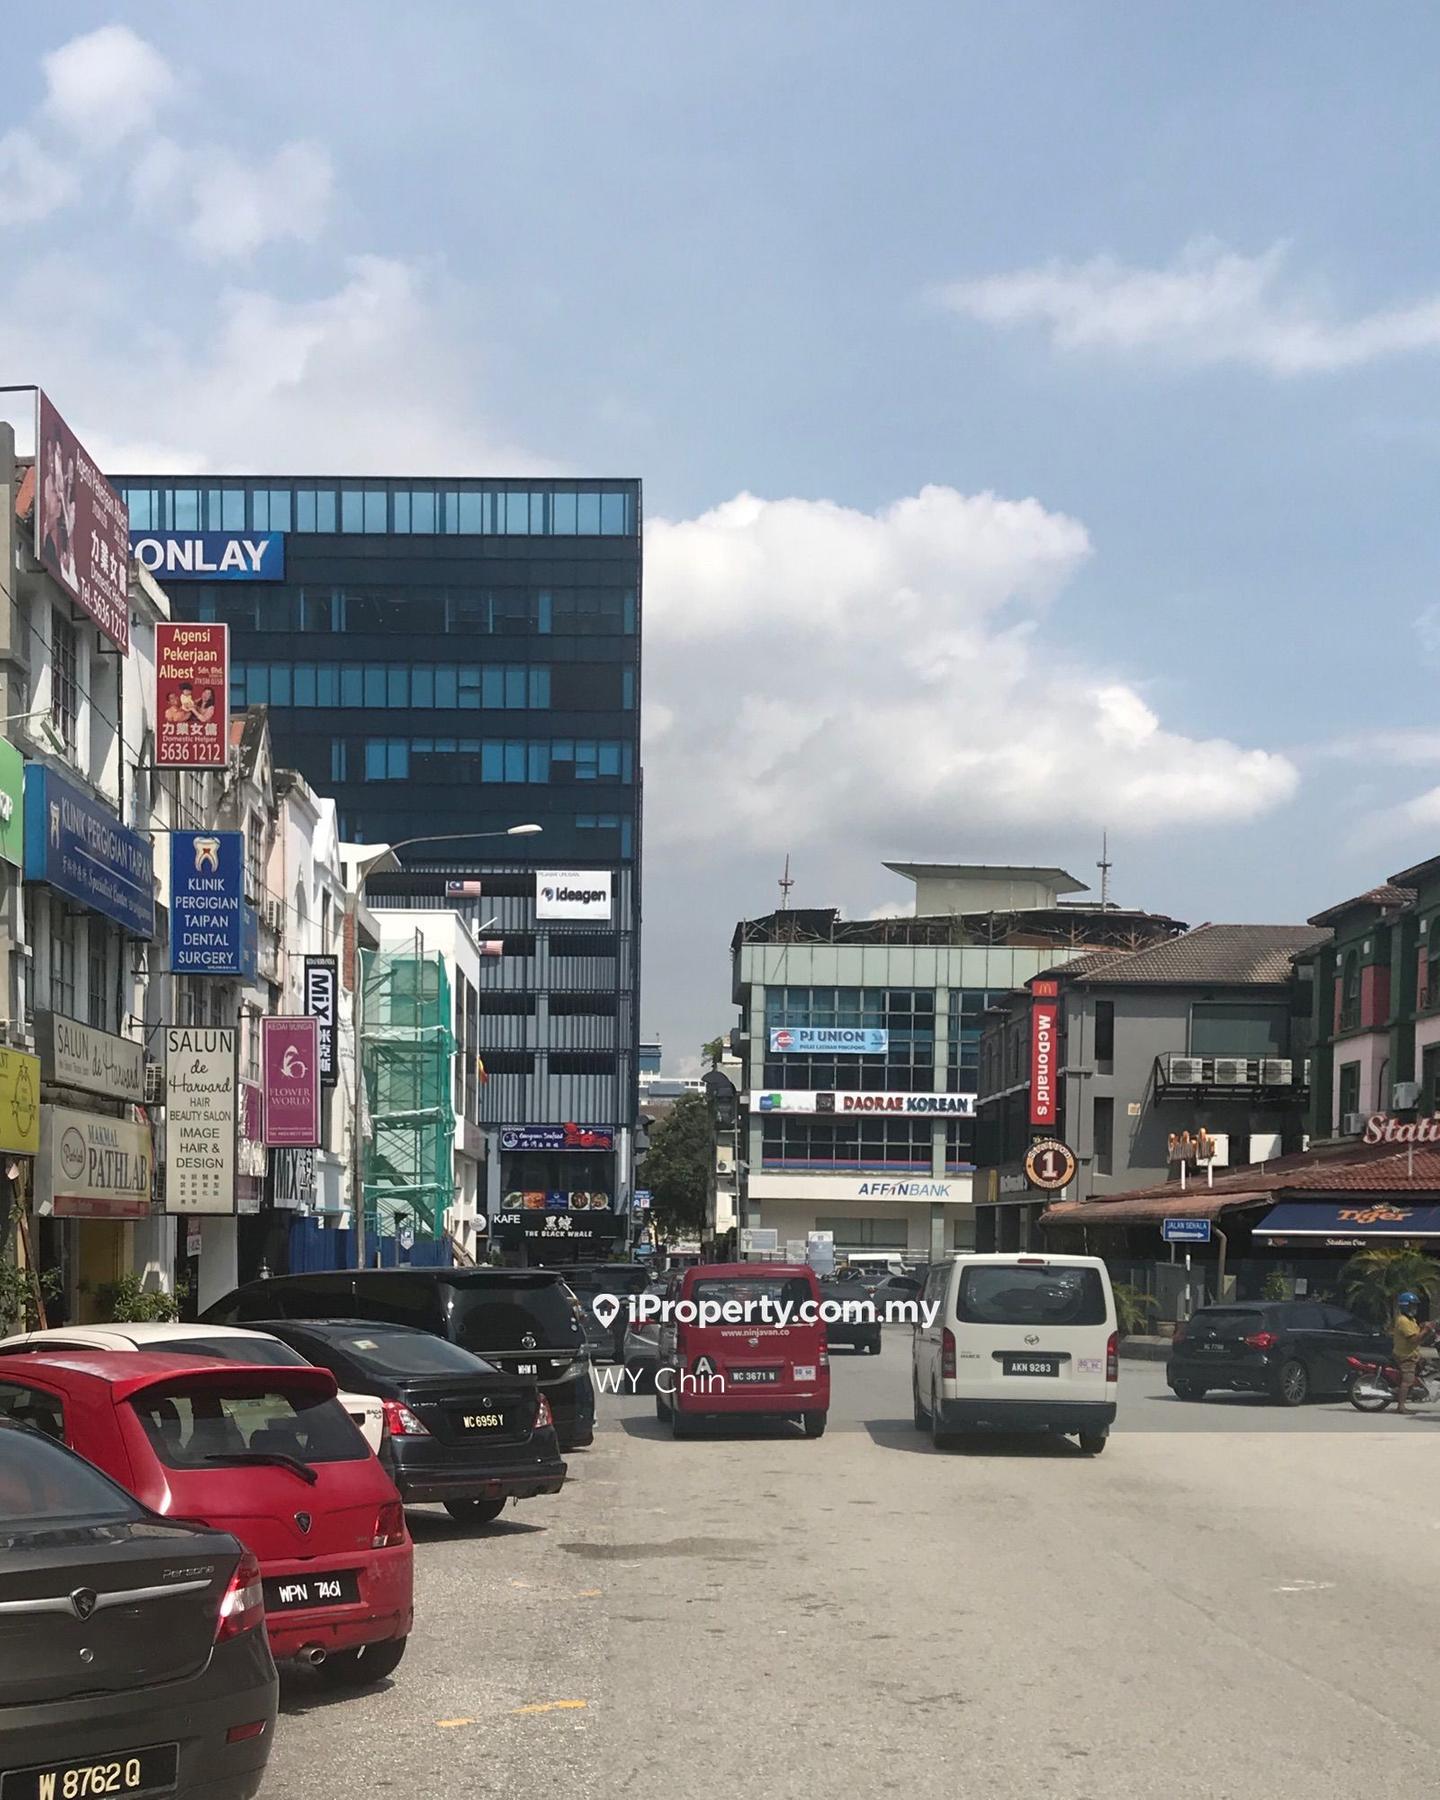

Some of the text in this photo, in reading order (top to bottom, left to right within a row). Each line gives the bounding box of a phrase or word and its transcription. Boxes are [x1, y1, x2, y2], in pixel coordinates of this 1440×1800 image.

[129, 538, 269, 571] ONLAY
[94, 590, 110, 629] 5636
[111, 610, 127, 646] 1212
[173, 629, 211, 645] Agensi
[163, 647, 217, 664] Pekerjaan
[160, 665, 194, 679] Albest
[161, 743, 220, 760] 5636 1212
[188, 878, 225, 891] KLINIK
[175, 896, 238, 910] PERGIGIAN
[185, 914, 229, 928] TAIPAN
[183, 933, 229, 946] DENTAL
[178, 950, 234, 964] SURGERY
[57, 1023, 89, 1062] SALUN
[169, 1030, 232, 1053] SALUN
[800, 1030, 865, 1042] PJ UNION
[191, 1058, 209, 1074] de
[1037, 1014, 1051, 1117] McDonald's
[168, 1073, 232, 1094] Harvard
[269, 1088, 310, 1097] FLOWER
[190, 1097, 211, 1107] HAIR
[271, 1097, 310, 1105] WORLD
[844, 1096, 968, 1112] DAORAE KOREAN
[170, 1110, 231, 1120] BEAUTY SALON
[180, 1127, 220, 1138] IMAGE
[180, 1143, 220, 1153] HAIR &
[88, 1148, 147, 1191] PATHLAB
[176, 1158, 224, 1168] DESIGN
[1042, 1151, 1058, 1178] 1
[494, 1214, 520, 1224] KAFE
[1337, 1208, 1413, 1224] Tiger
[721, 1328, 790, 1339] www.ninjavan.co
[695, 1357, 713, 1375] A
[1012, 1363, 1051, 1373] AKN 9283
[463, 1414, 503, 1428] WC 6956 Y
[162, 1566, 214, 1580] Persona
[279, 1580, 341, 1603] WPN 7461
[39, 1758, 140, 1800] W 8762 Q
